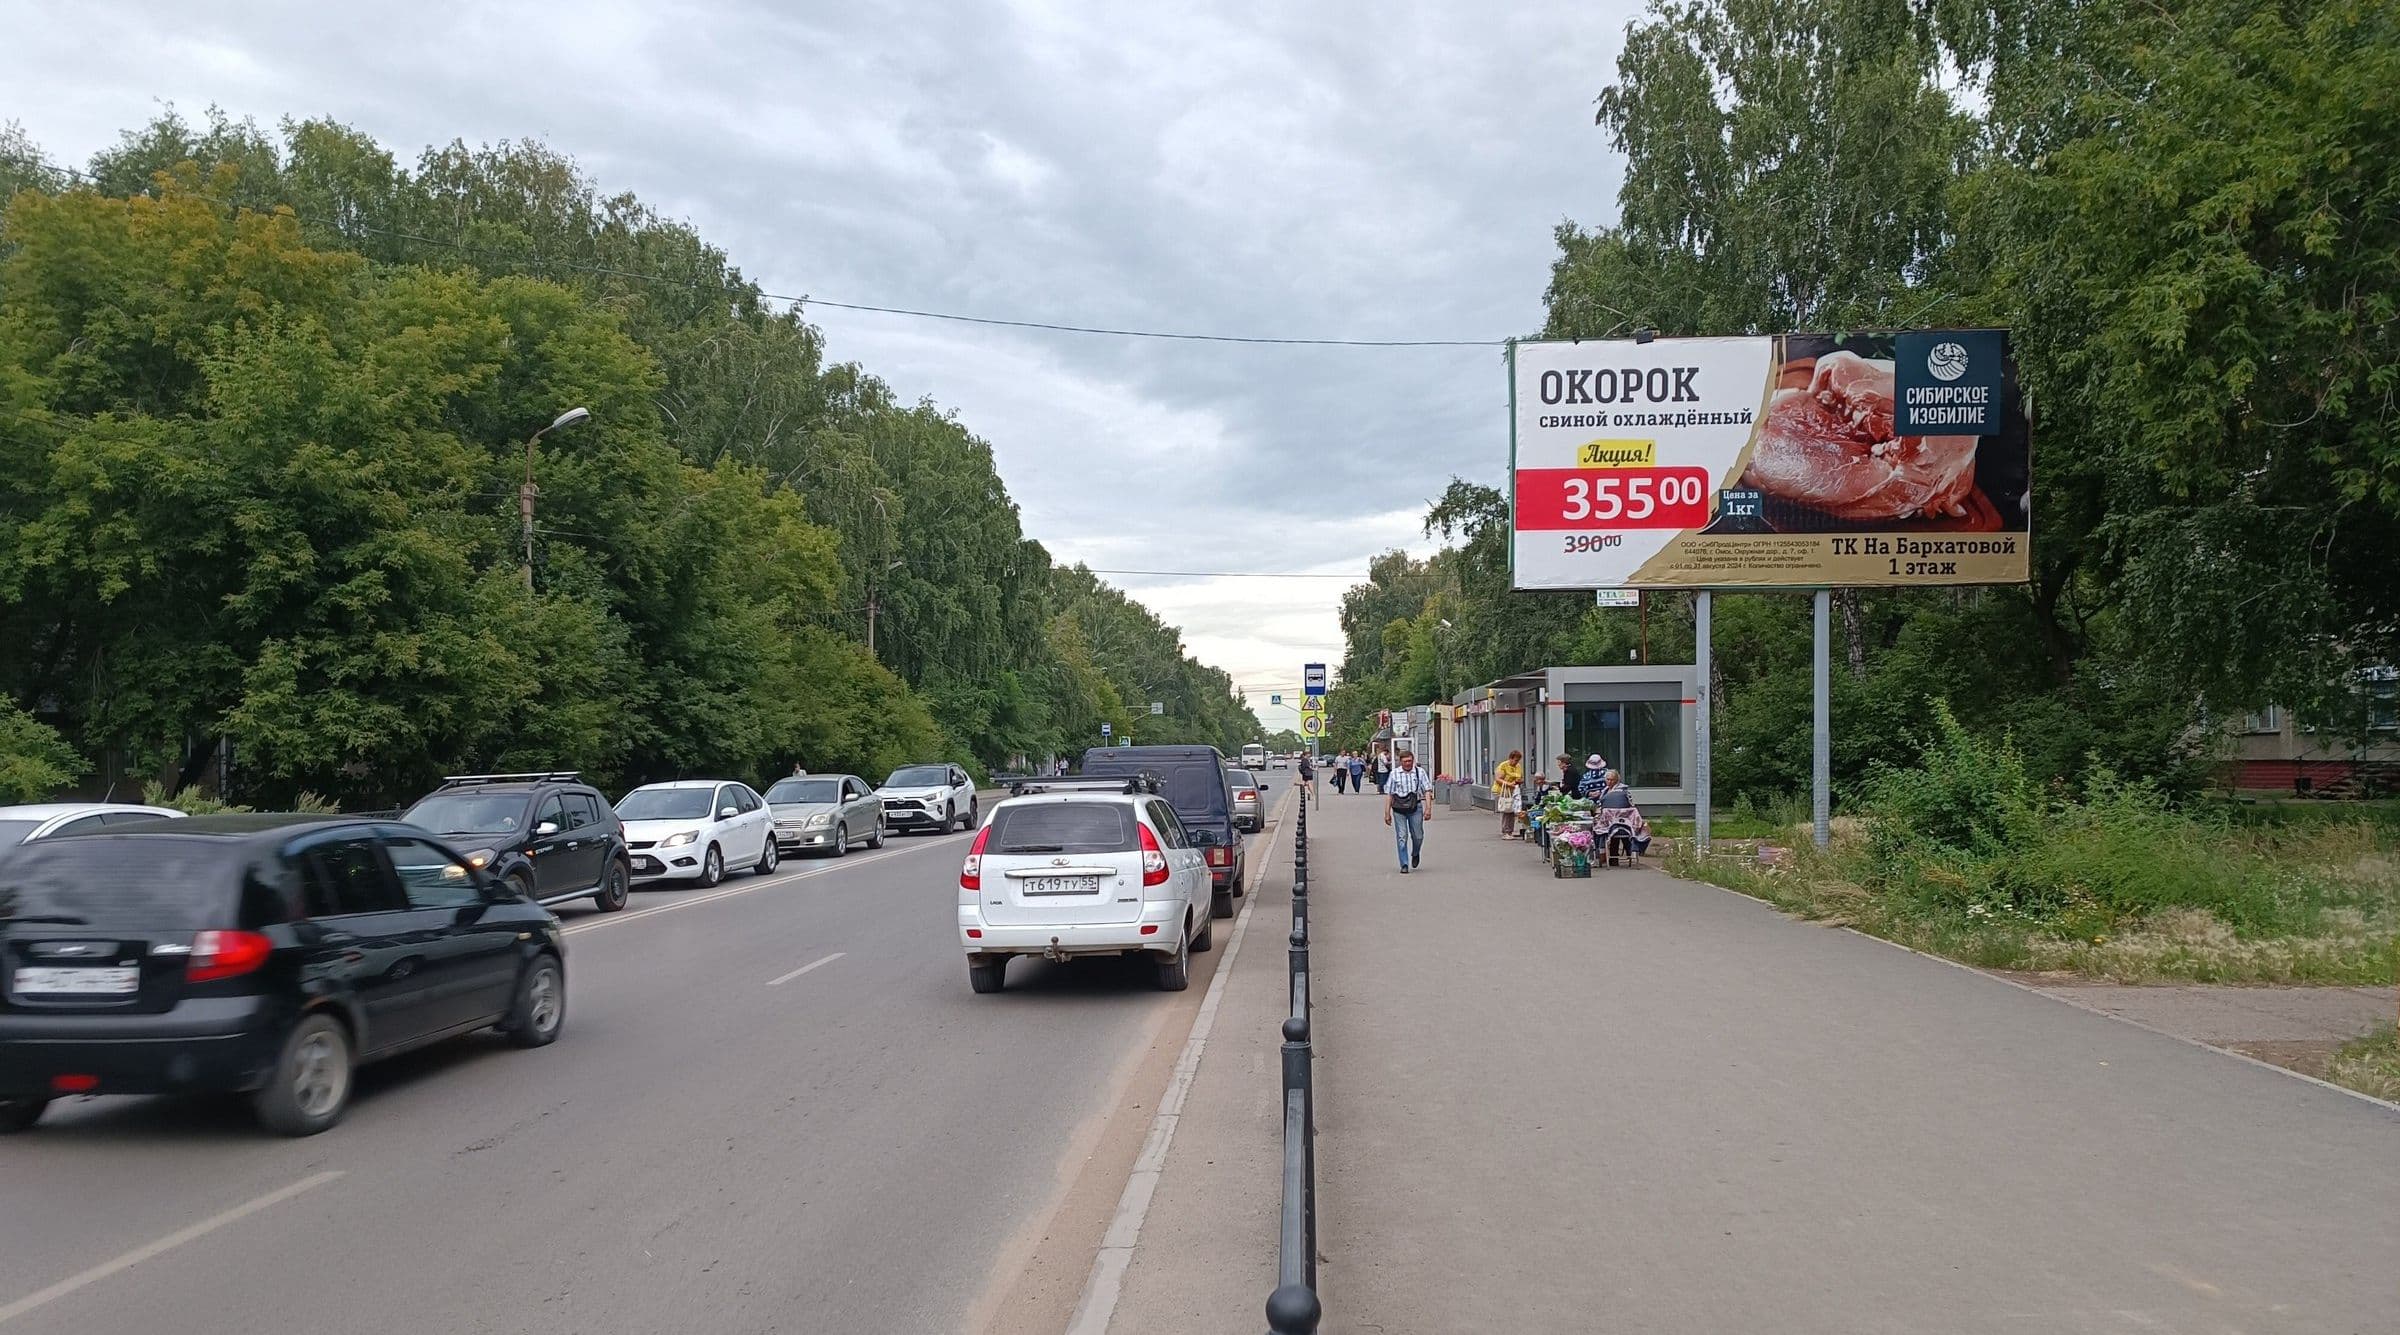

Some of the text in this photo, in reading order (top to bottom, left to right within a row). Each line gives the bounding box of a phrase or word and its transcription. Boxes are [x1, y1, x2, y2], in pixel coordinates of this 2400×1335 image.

[1540, 367, 1700, 405] ОКОРОК
[1906, 386, 1989, 404] СИБИРСКОЕ
[1539, 408, 1753, 427] свиной охлаждённый
[1909, 406, 1985, 424] ИЗОБИЛИЕ
[1583, 443, 1653, 467] Акция!
[1722, 490, 1759, 500] Цена за
[1726, 502, 1755, 515] 1кг
[1832, 537, 2016, 558] ТК На Бархатовой
[1889, 558, 1957, 575] 1 этаж
